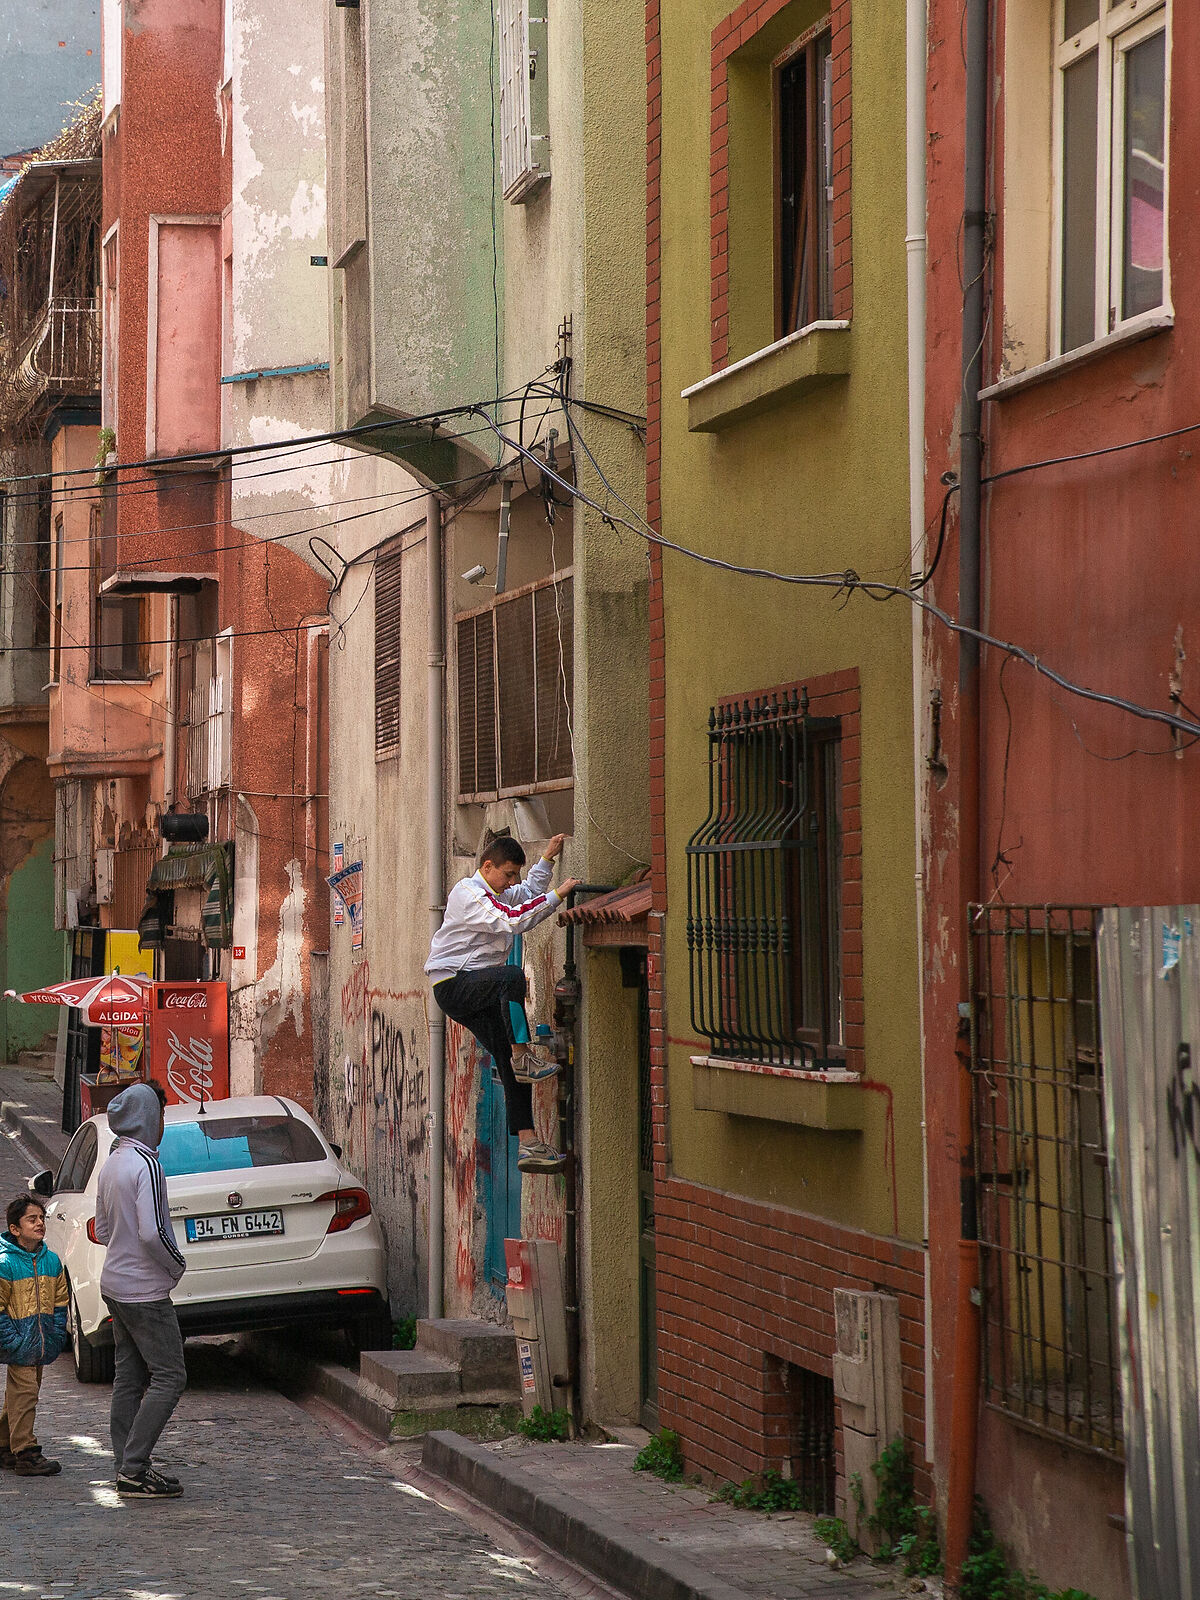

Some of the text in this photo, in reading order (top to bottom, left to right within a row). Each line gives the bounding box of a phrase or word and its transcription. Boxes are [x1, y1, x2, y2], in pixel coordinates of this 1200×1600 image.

[165, 992, 208, 1009] Coca-Cola
[98, 1011, 139, 1021] ALGIDA
[196, 1213, 281, 1236] 34 FN 6442
